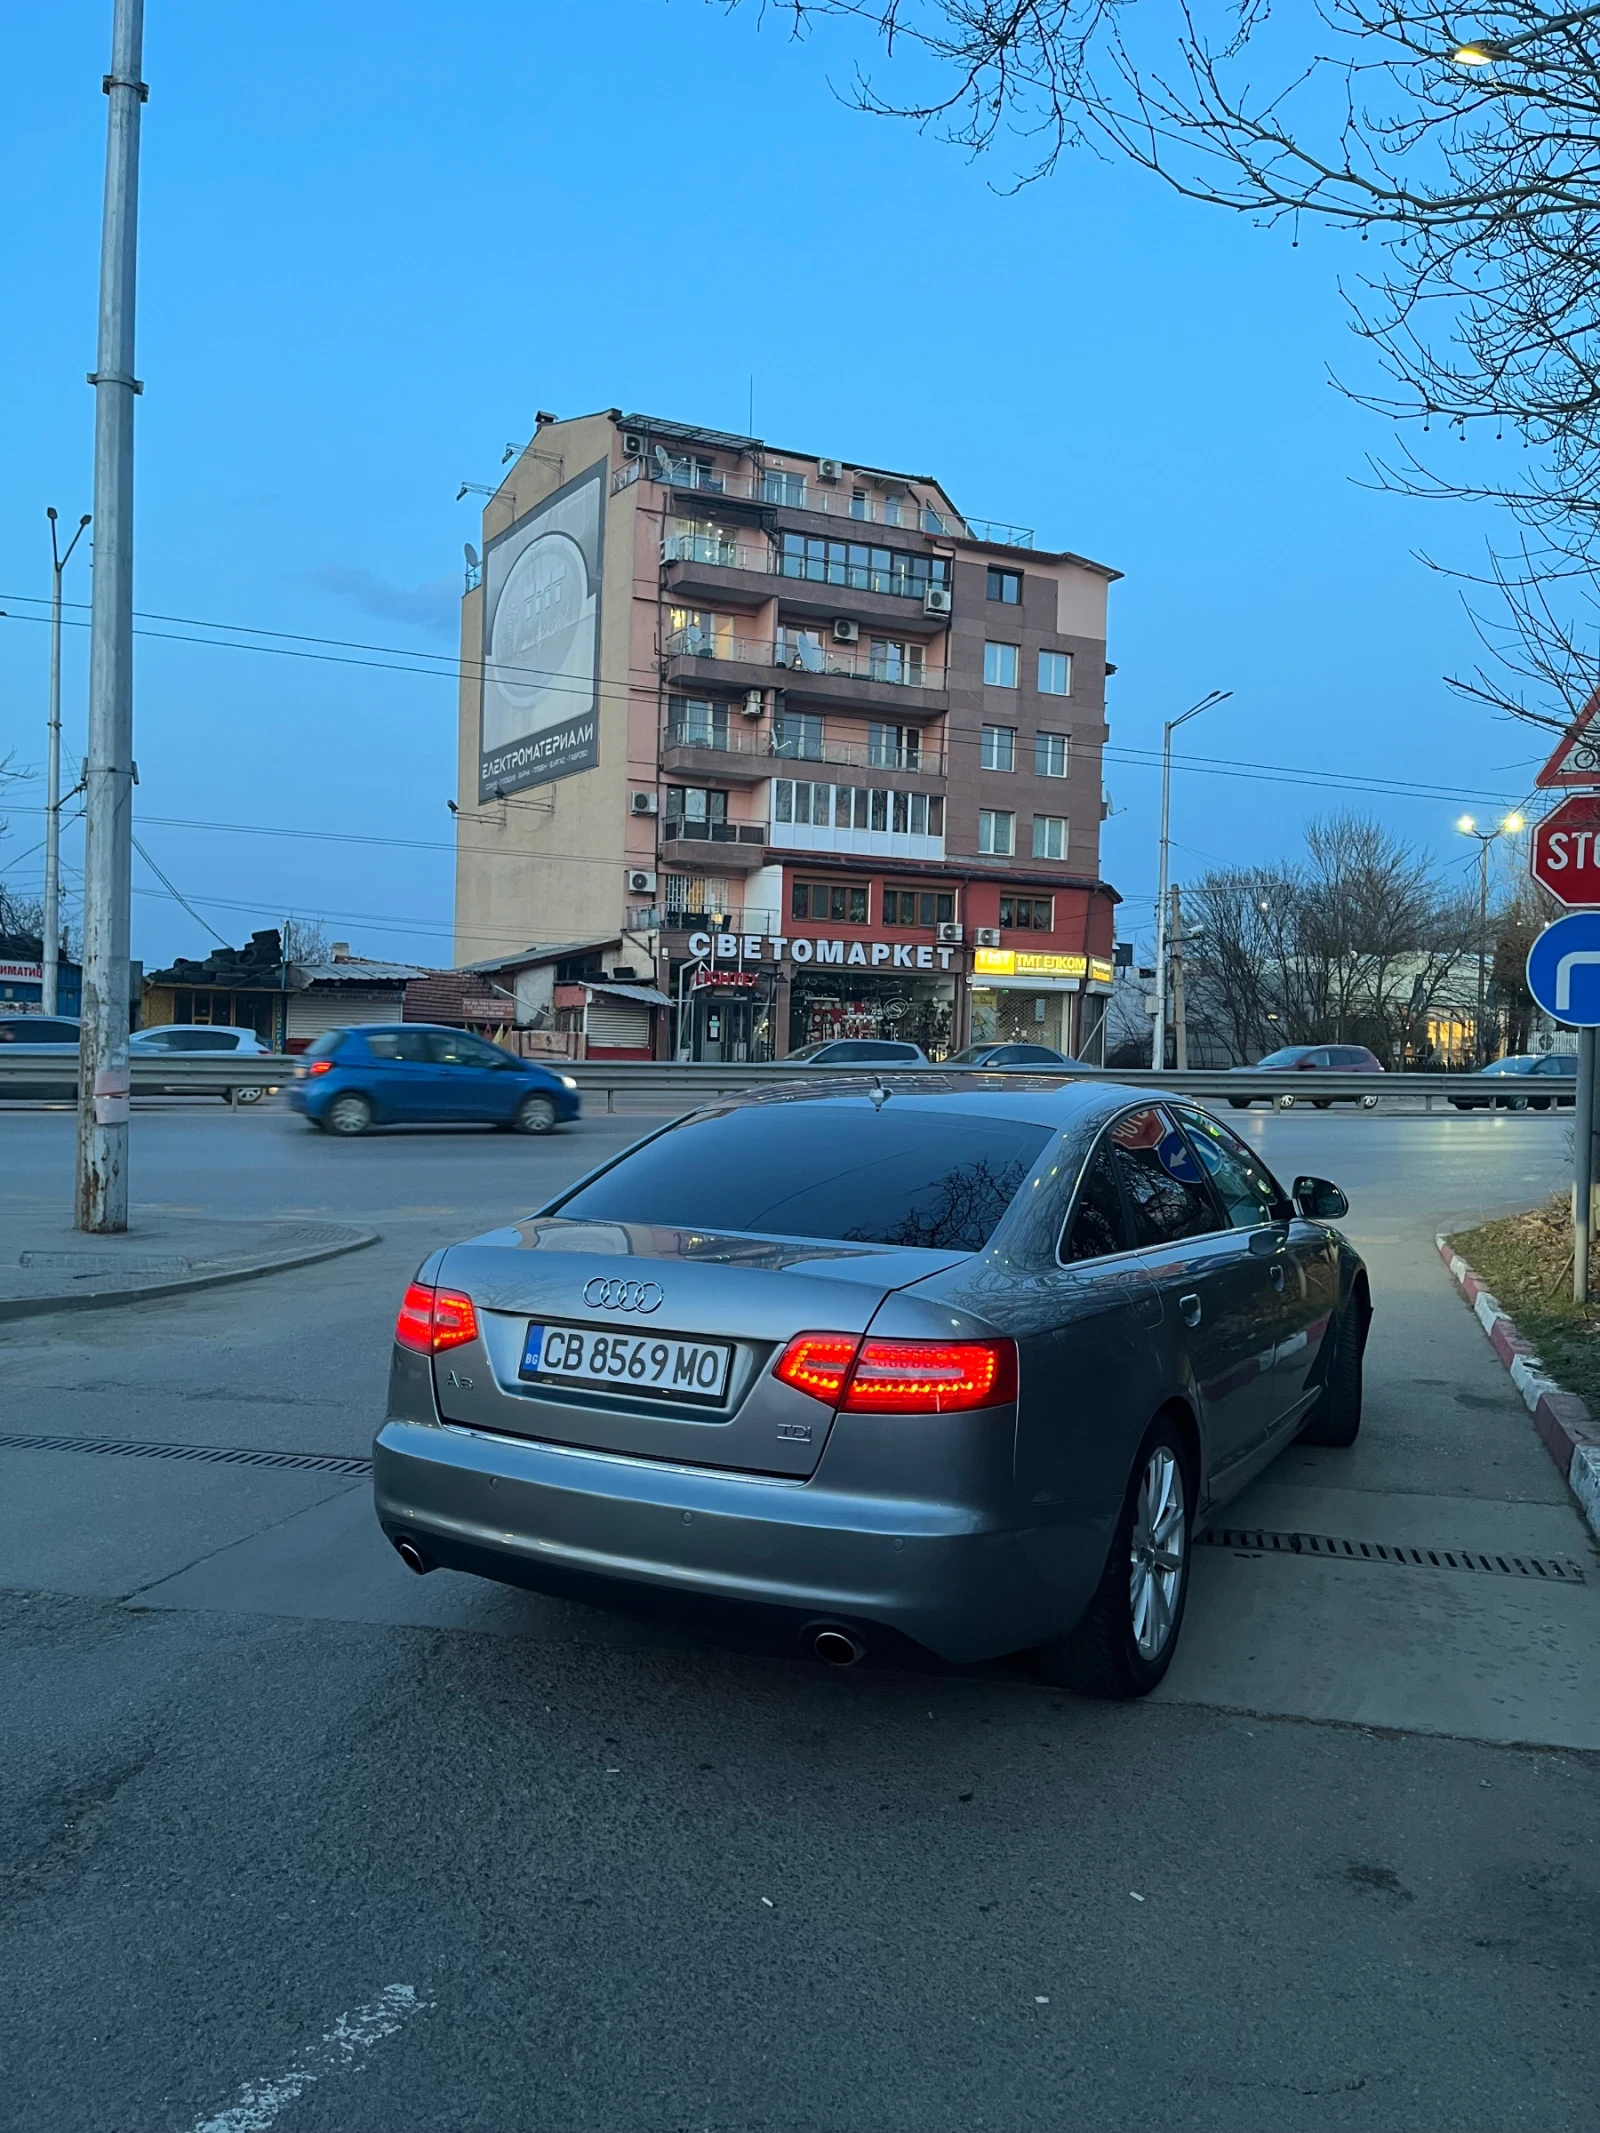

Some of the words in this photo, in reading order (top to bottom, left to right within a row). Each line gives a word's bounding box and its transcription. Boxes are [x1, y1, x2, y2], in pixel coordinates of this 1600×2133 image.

[482, 723, 594, 779] ЕЛЕКТРОМАТЕРИАЛИ
[688, 932, 955, 969] СВЕТОМАРКЕТ
[1044, 956, 1087, 970] ЕЛКОМ
[525, 1353, 539, 1365] BG
[543, 1332, 585, 1370] CB
[589, 1337, 669, 1381] 8569
[673, 1346, 719, 1388] MO
